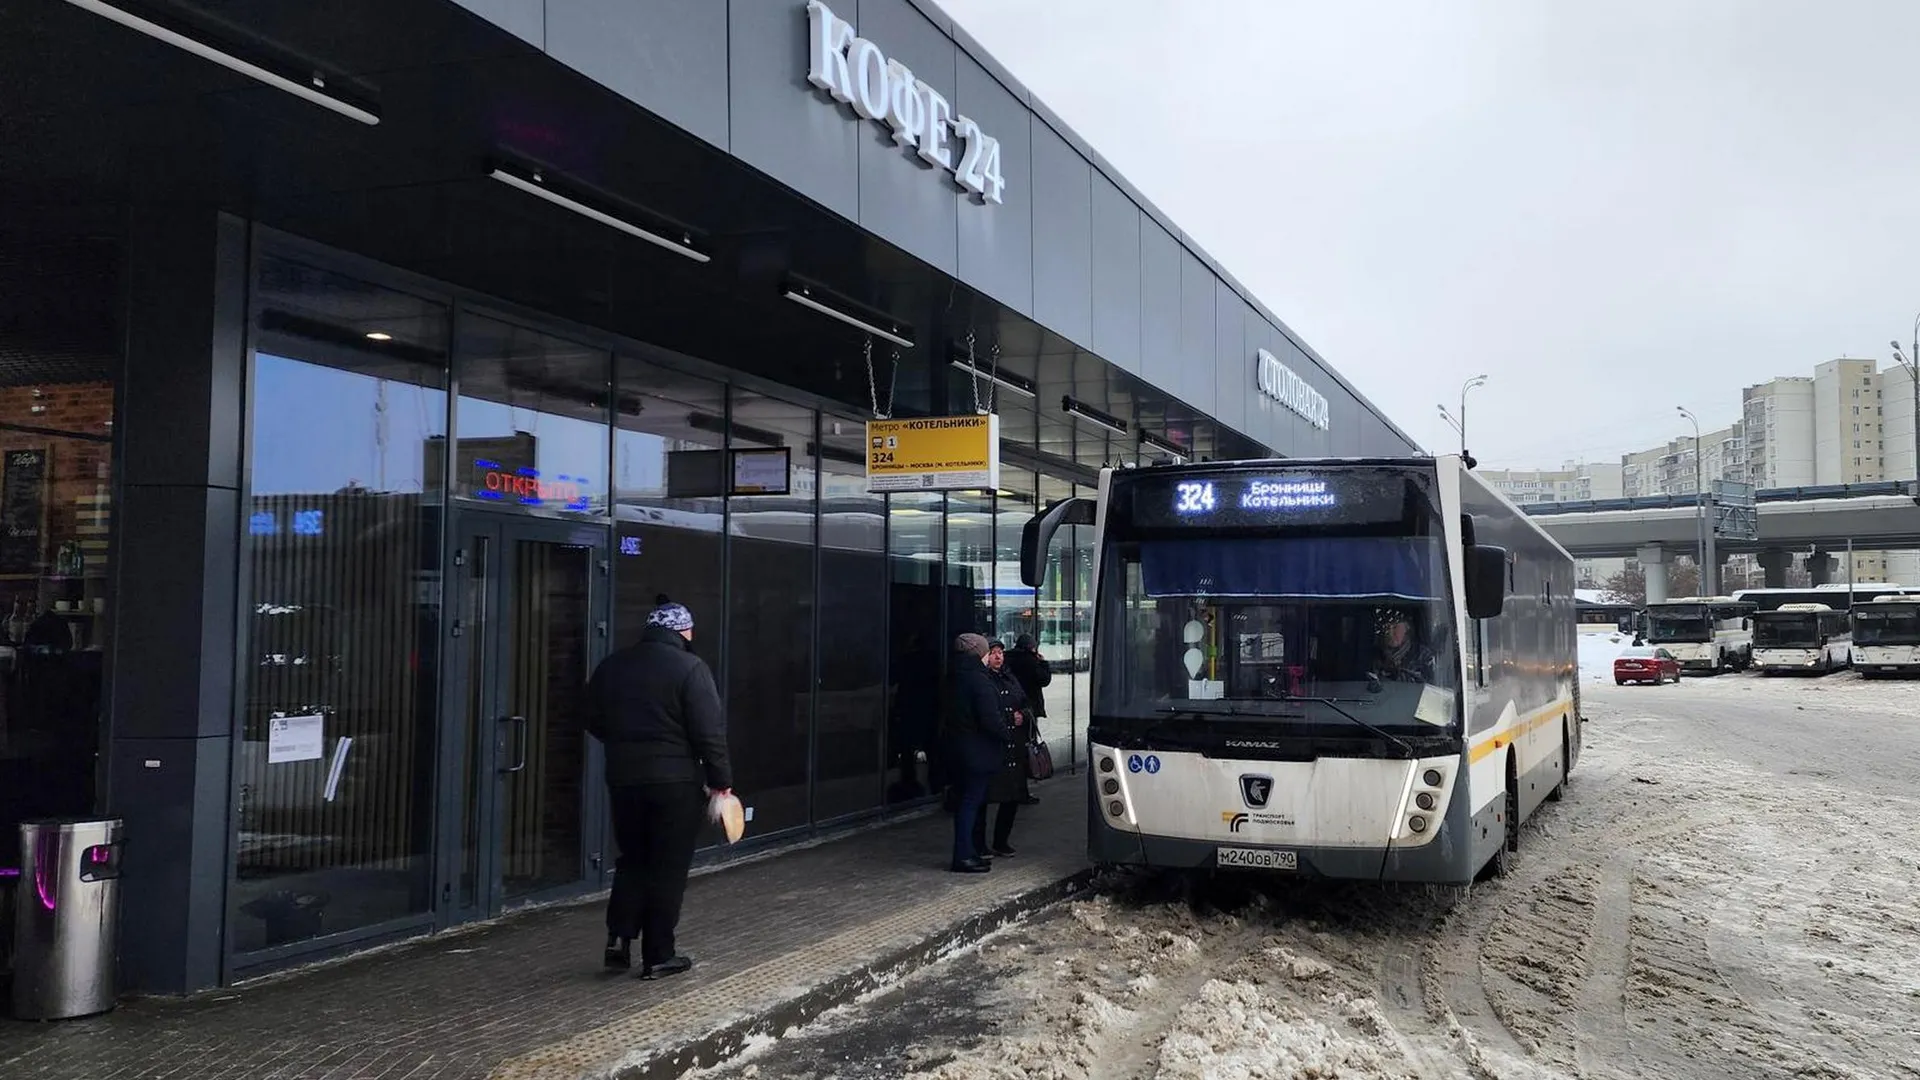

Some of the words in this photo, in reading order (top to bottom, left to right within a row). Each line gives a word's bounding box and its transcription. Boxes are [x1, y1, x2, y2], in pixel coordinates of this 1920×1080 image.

[806, 0, 951, 171] КОФЕ
[955, 114, 1005, 205] 24
[871, 423, 900, 432] Метро
[902, 418, 986, 430] «КОТЕЛЬНИКИ»
[872, 453, 894, 463] 324
[1250, 481, 1326, 495] Бронницы
[1176, 482, 1215, 511] 324
[1242, 494, 1335, 508] Котельники
[1225, 740, 1280, 749] KAMAZ
